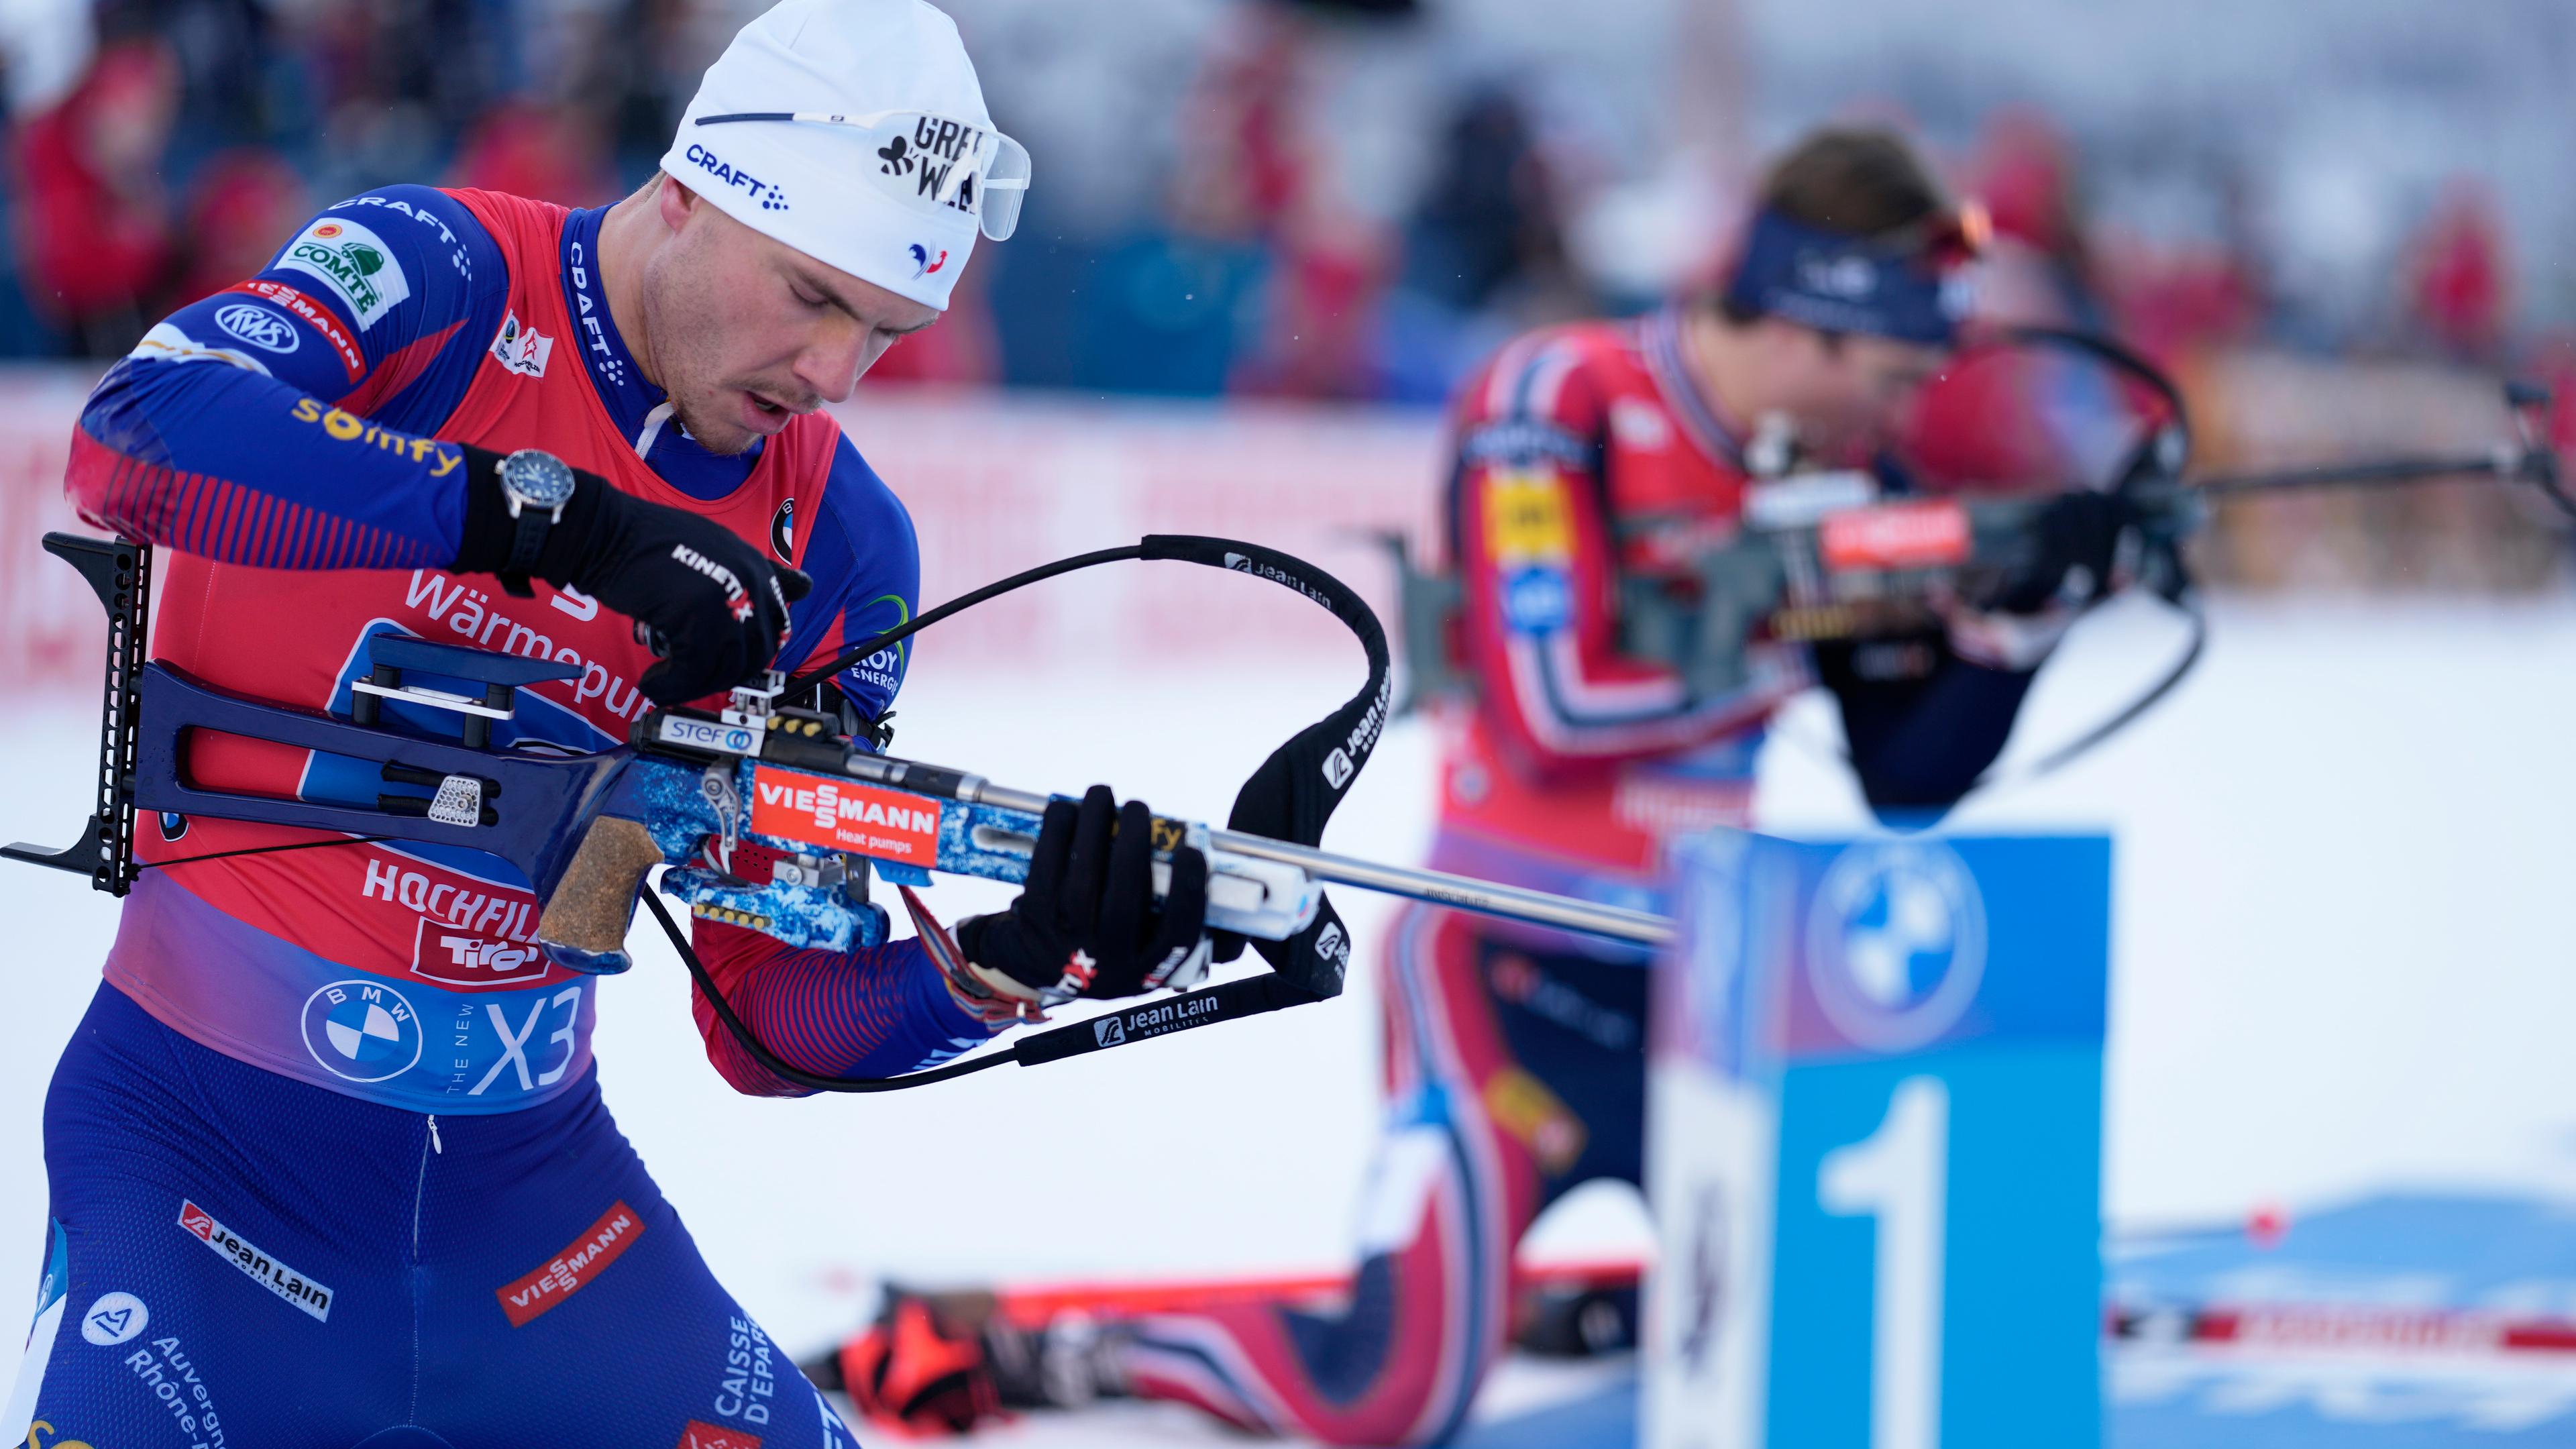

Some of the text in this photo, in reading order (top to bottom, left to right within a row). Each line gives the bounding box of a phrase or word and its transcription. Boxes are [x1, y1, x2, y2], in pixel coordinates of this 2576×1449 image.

[686, 144, 766, 197] CRAFT
[328, 197, 457, 244] CRAFT
[571, 241, 612, 356] CRAFT
[223, 307, 292, 347] RWS
[292, 398, 462, 477] somfy
[1255, 564, 1297, 588] Jean
[1347, 705, 1379, 757] Jean
[759, 782, 934, 835] VIESSMANN
[836, 828, 912, 855] Heat pumps
[326, 986, 410, 1022] BMW
[1127, 996, 1218, 1032] Jean Lain
[447, 1004, 474, 1094] THE NEW
[468, 986, 582, 1095] X3
[212, 1231, 328, 1309] Jean Lain
[510, 1214, 631, 1307] VIESSMANN
[714, 1316, 751, 1417] CAISSE
